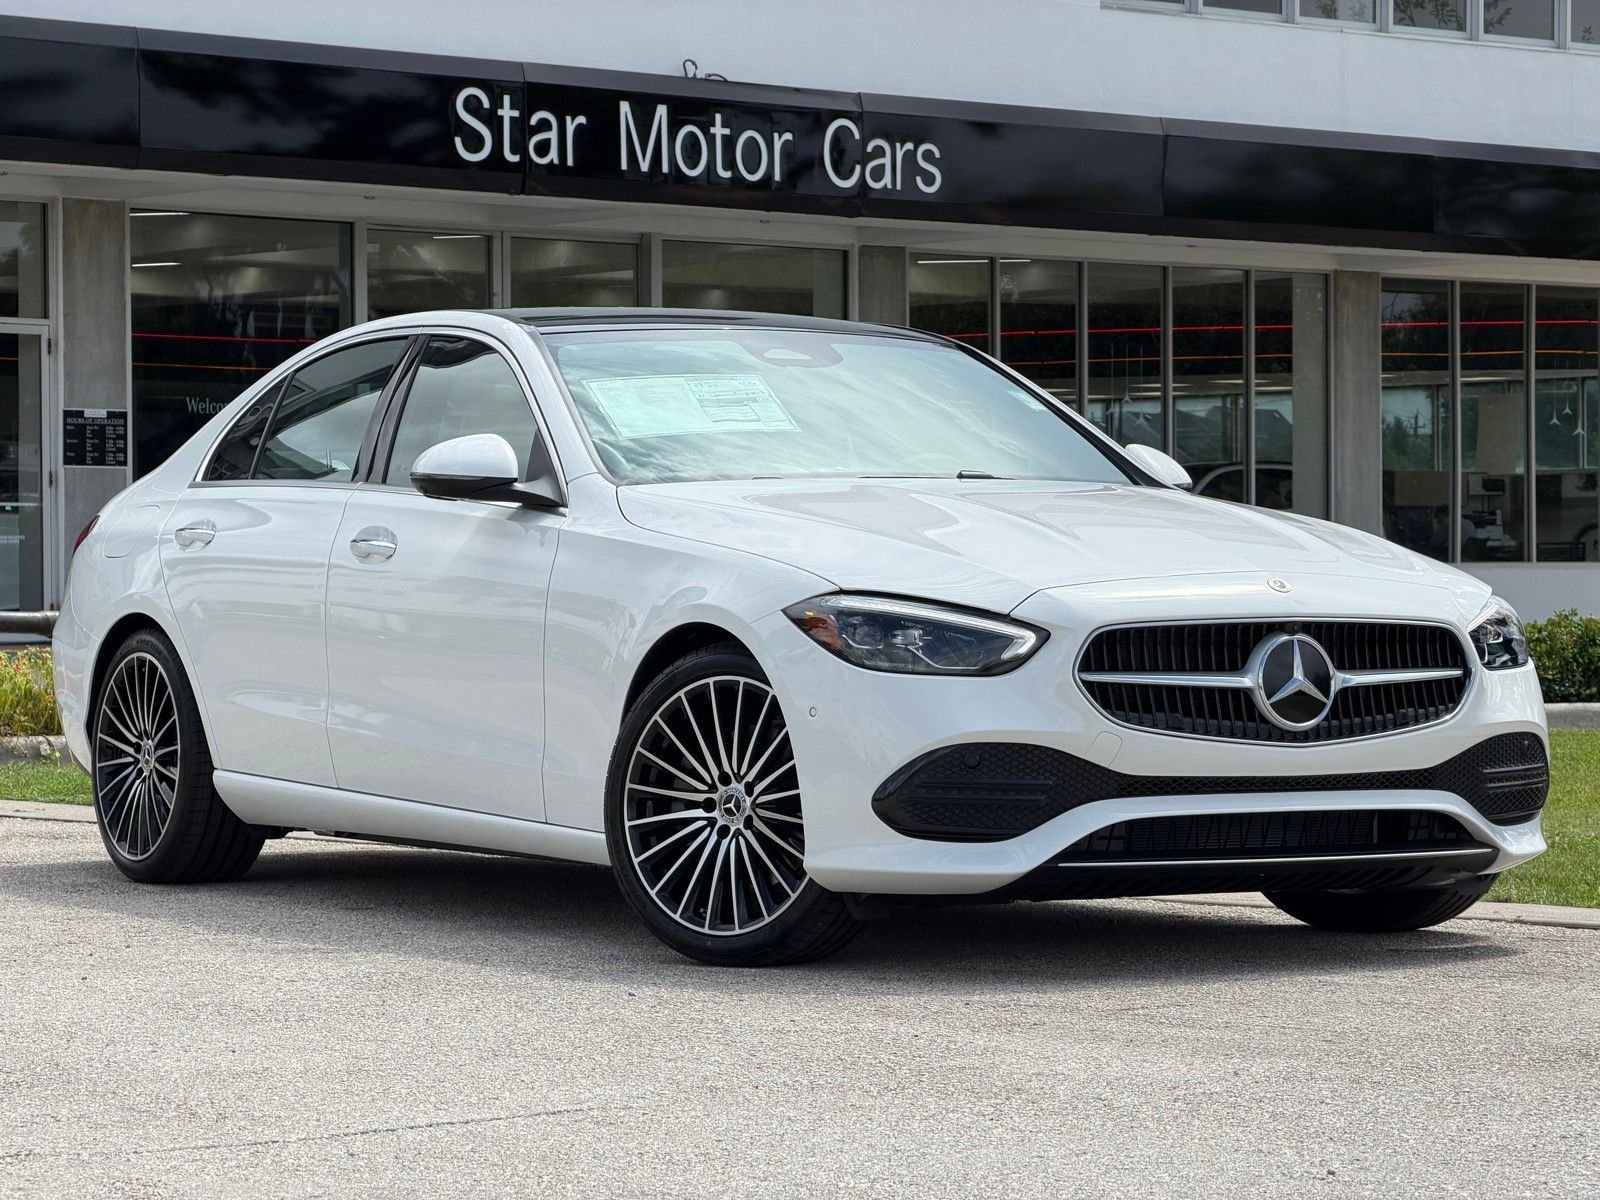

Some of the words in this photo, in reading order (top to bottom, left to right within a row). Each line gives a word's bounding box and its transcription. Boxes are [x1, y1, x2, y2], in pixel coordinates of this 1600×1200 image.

[454, 87, 587, 167] Star
[619, 100, 793, 182] Motor
[823, 118, 942, 194] Cars
[186, 397, 228, 415] Welco
